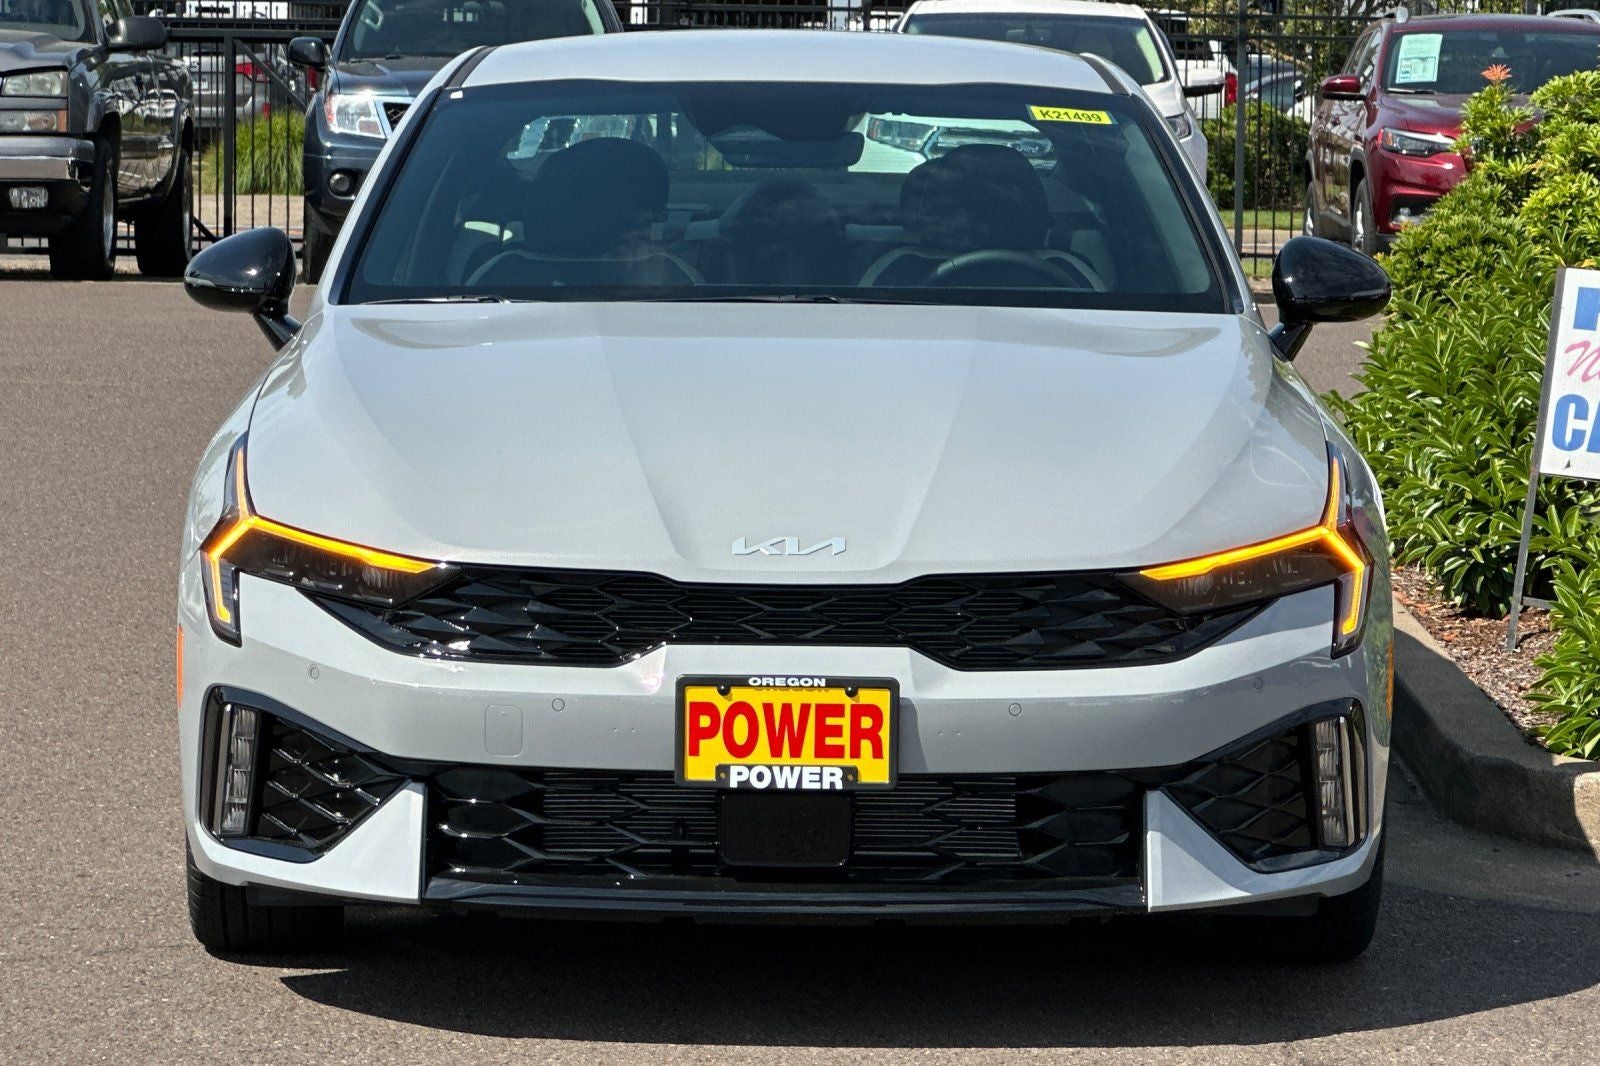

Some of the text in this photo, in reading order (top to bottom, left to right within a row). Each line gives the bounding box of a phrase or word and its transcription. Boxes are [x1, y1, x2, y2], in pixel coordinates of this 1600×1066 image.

[1039, 109, 1103, 122] K21499
[747, 677, 827, 688] OREGON
[687, 700, 885, 760] POWER
[729, 765, 844, 790] POWER
